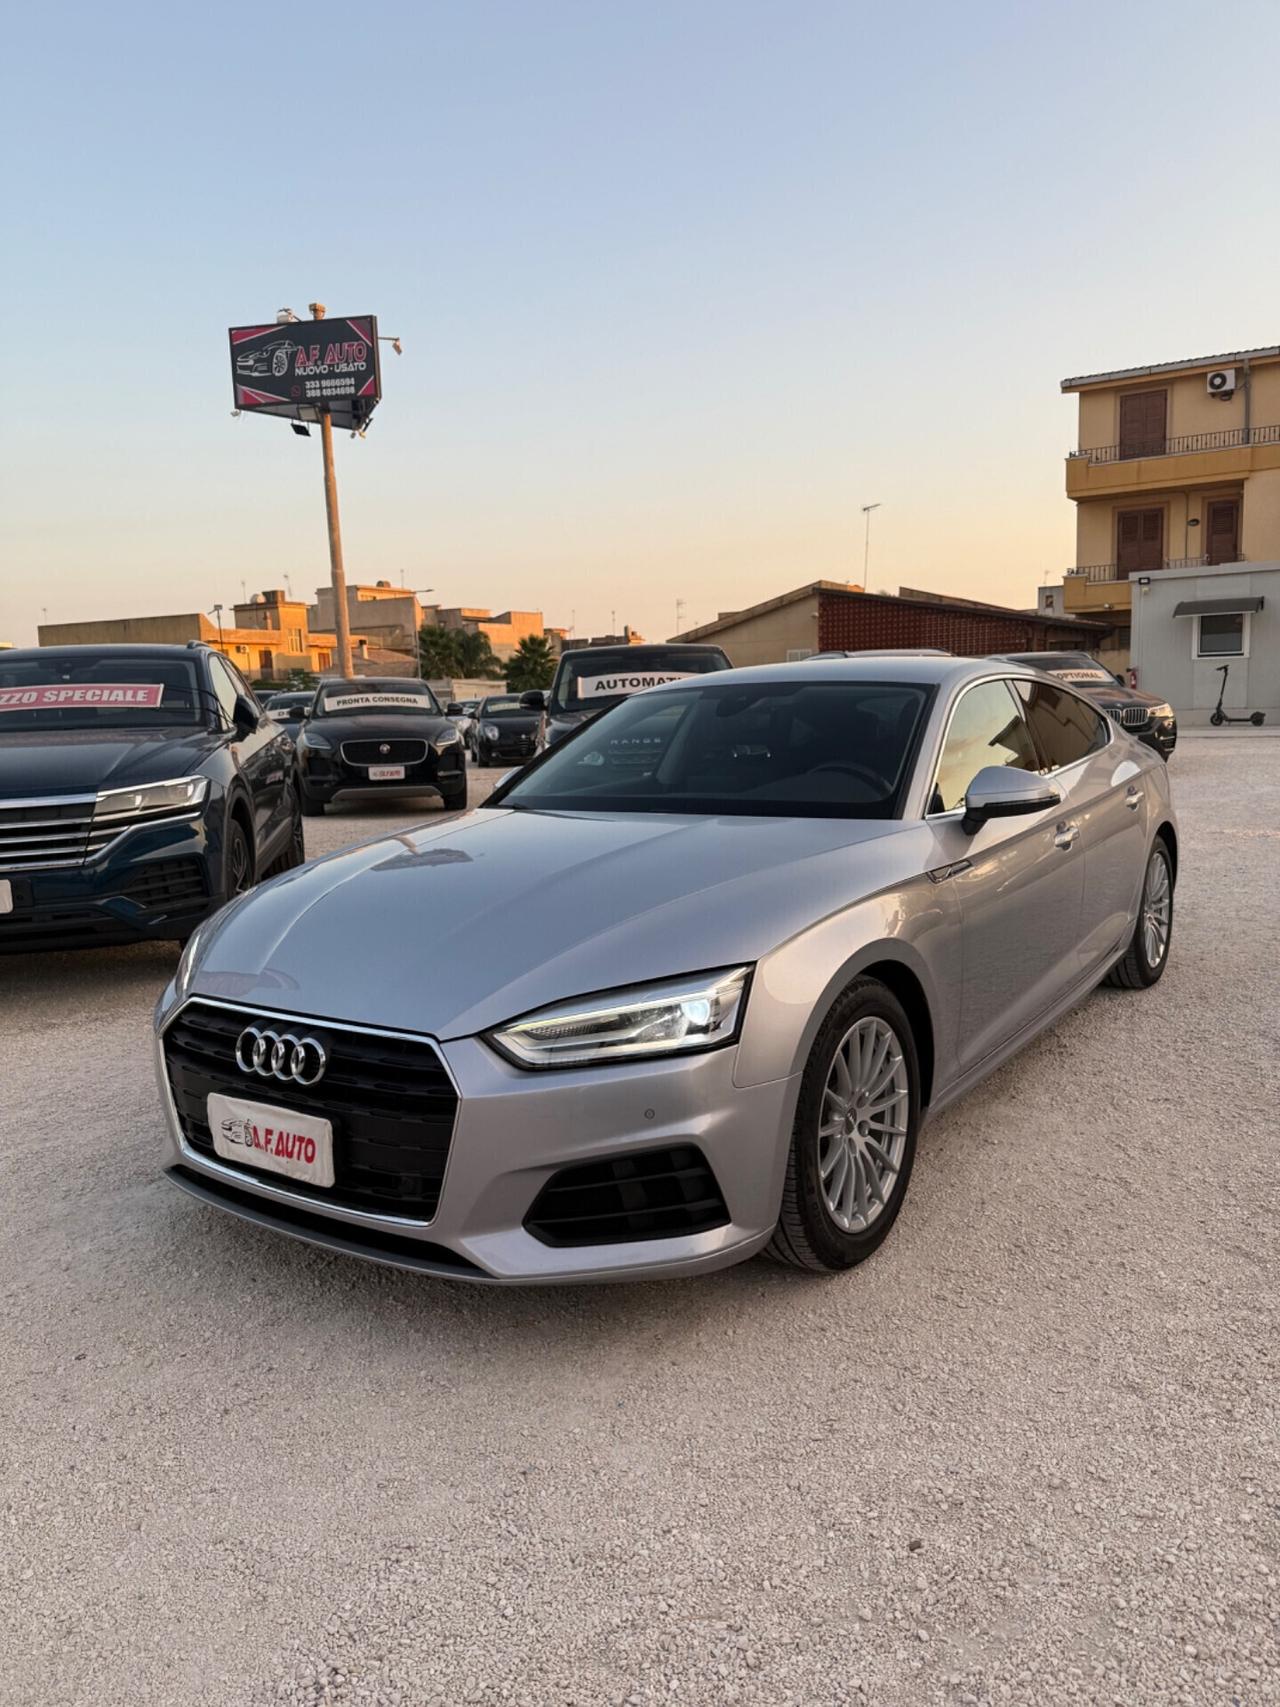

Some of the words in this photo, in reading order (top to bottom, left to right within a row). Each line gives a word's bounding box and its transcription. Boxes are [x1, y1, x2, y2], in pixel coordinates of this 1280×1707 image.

[324, 341, 366, 364] AUTO
[295, 365, 328, 376] NUOVO
[334, 363, 366, 372] USATO
[1056, 671, 1102, 680] OPTIONAL
[42, 689, 148, 702] SPECIALE
[336, 697, 370, 706] PRONTA
[372, 696, 418, 704] CONSEGNA
